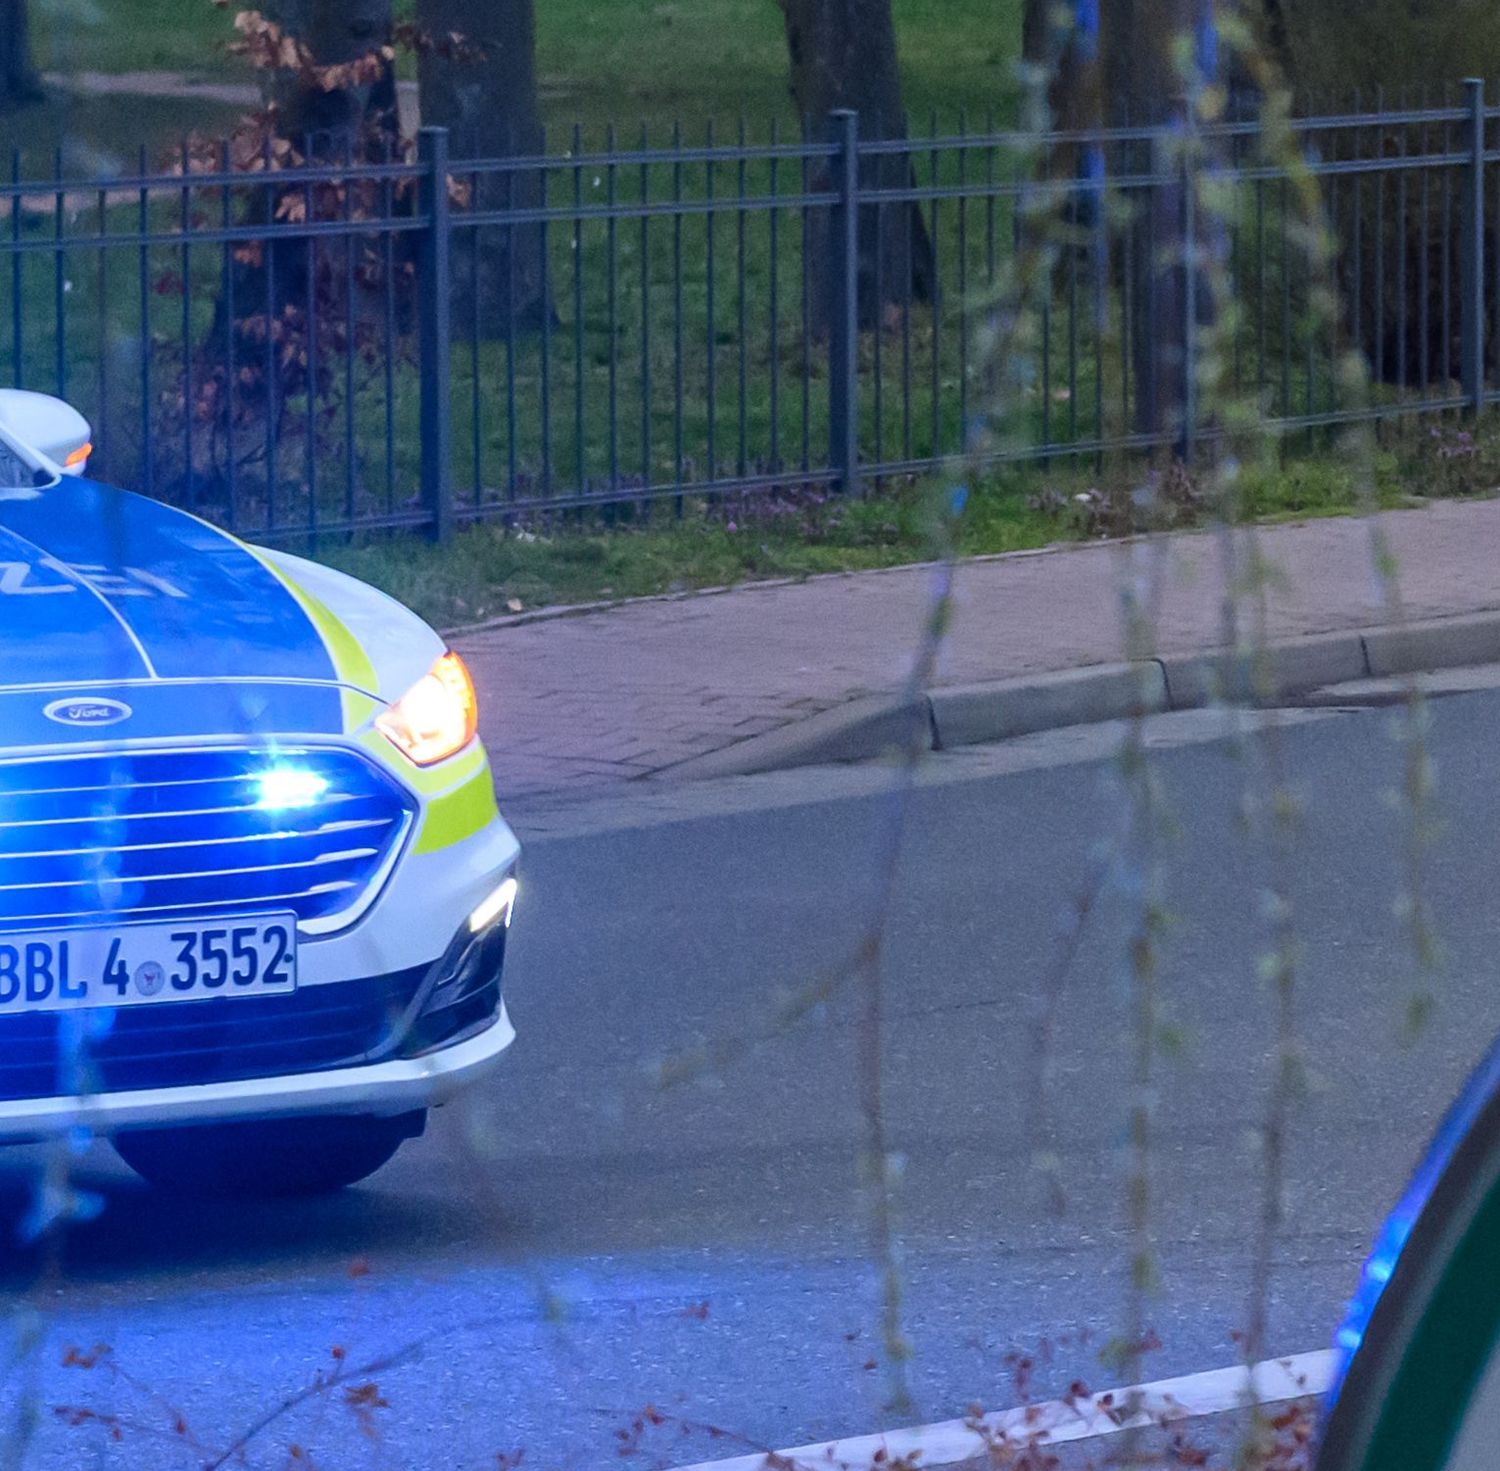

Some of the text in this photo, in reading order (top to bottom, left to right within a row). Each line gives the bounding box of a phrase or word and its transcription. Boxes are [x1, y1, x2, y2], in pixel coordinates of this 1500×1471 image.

[67, 704, 110, 719] Ford
[102, 937, 130, 996] 4
[170, 925, 289, 991] 3552
